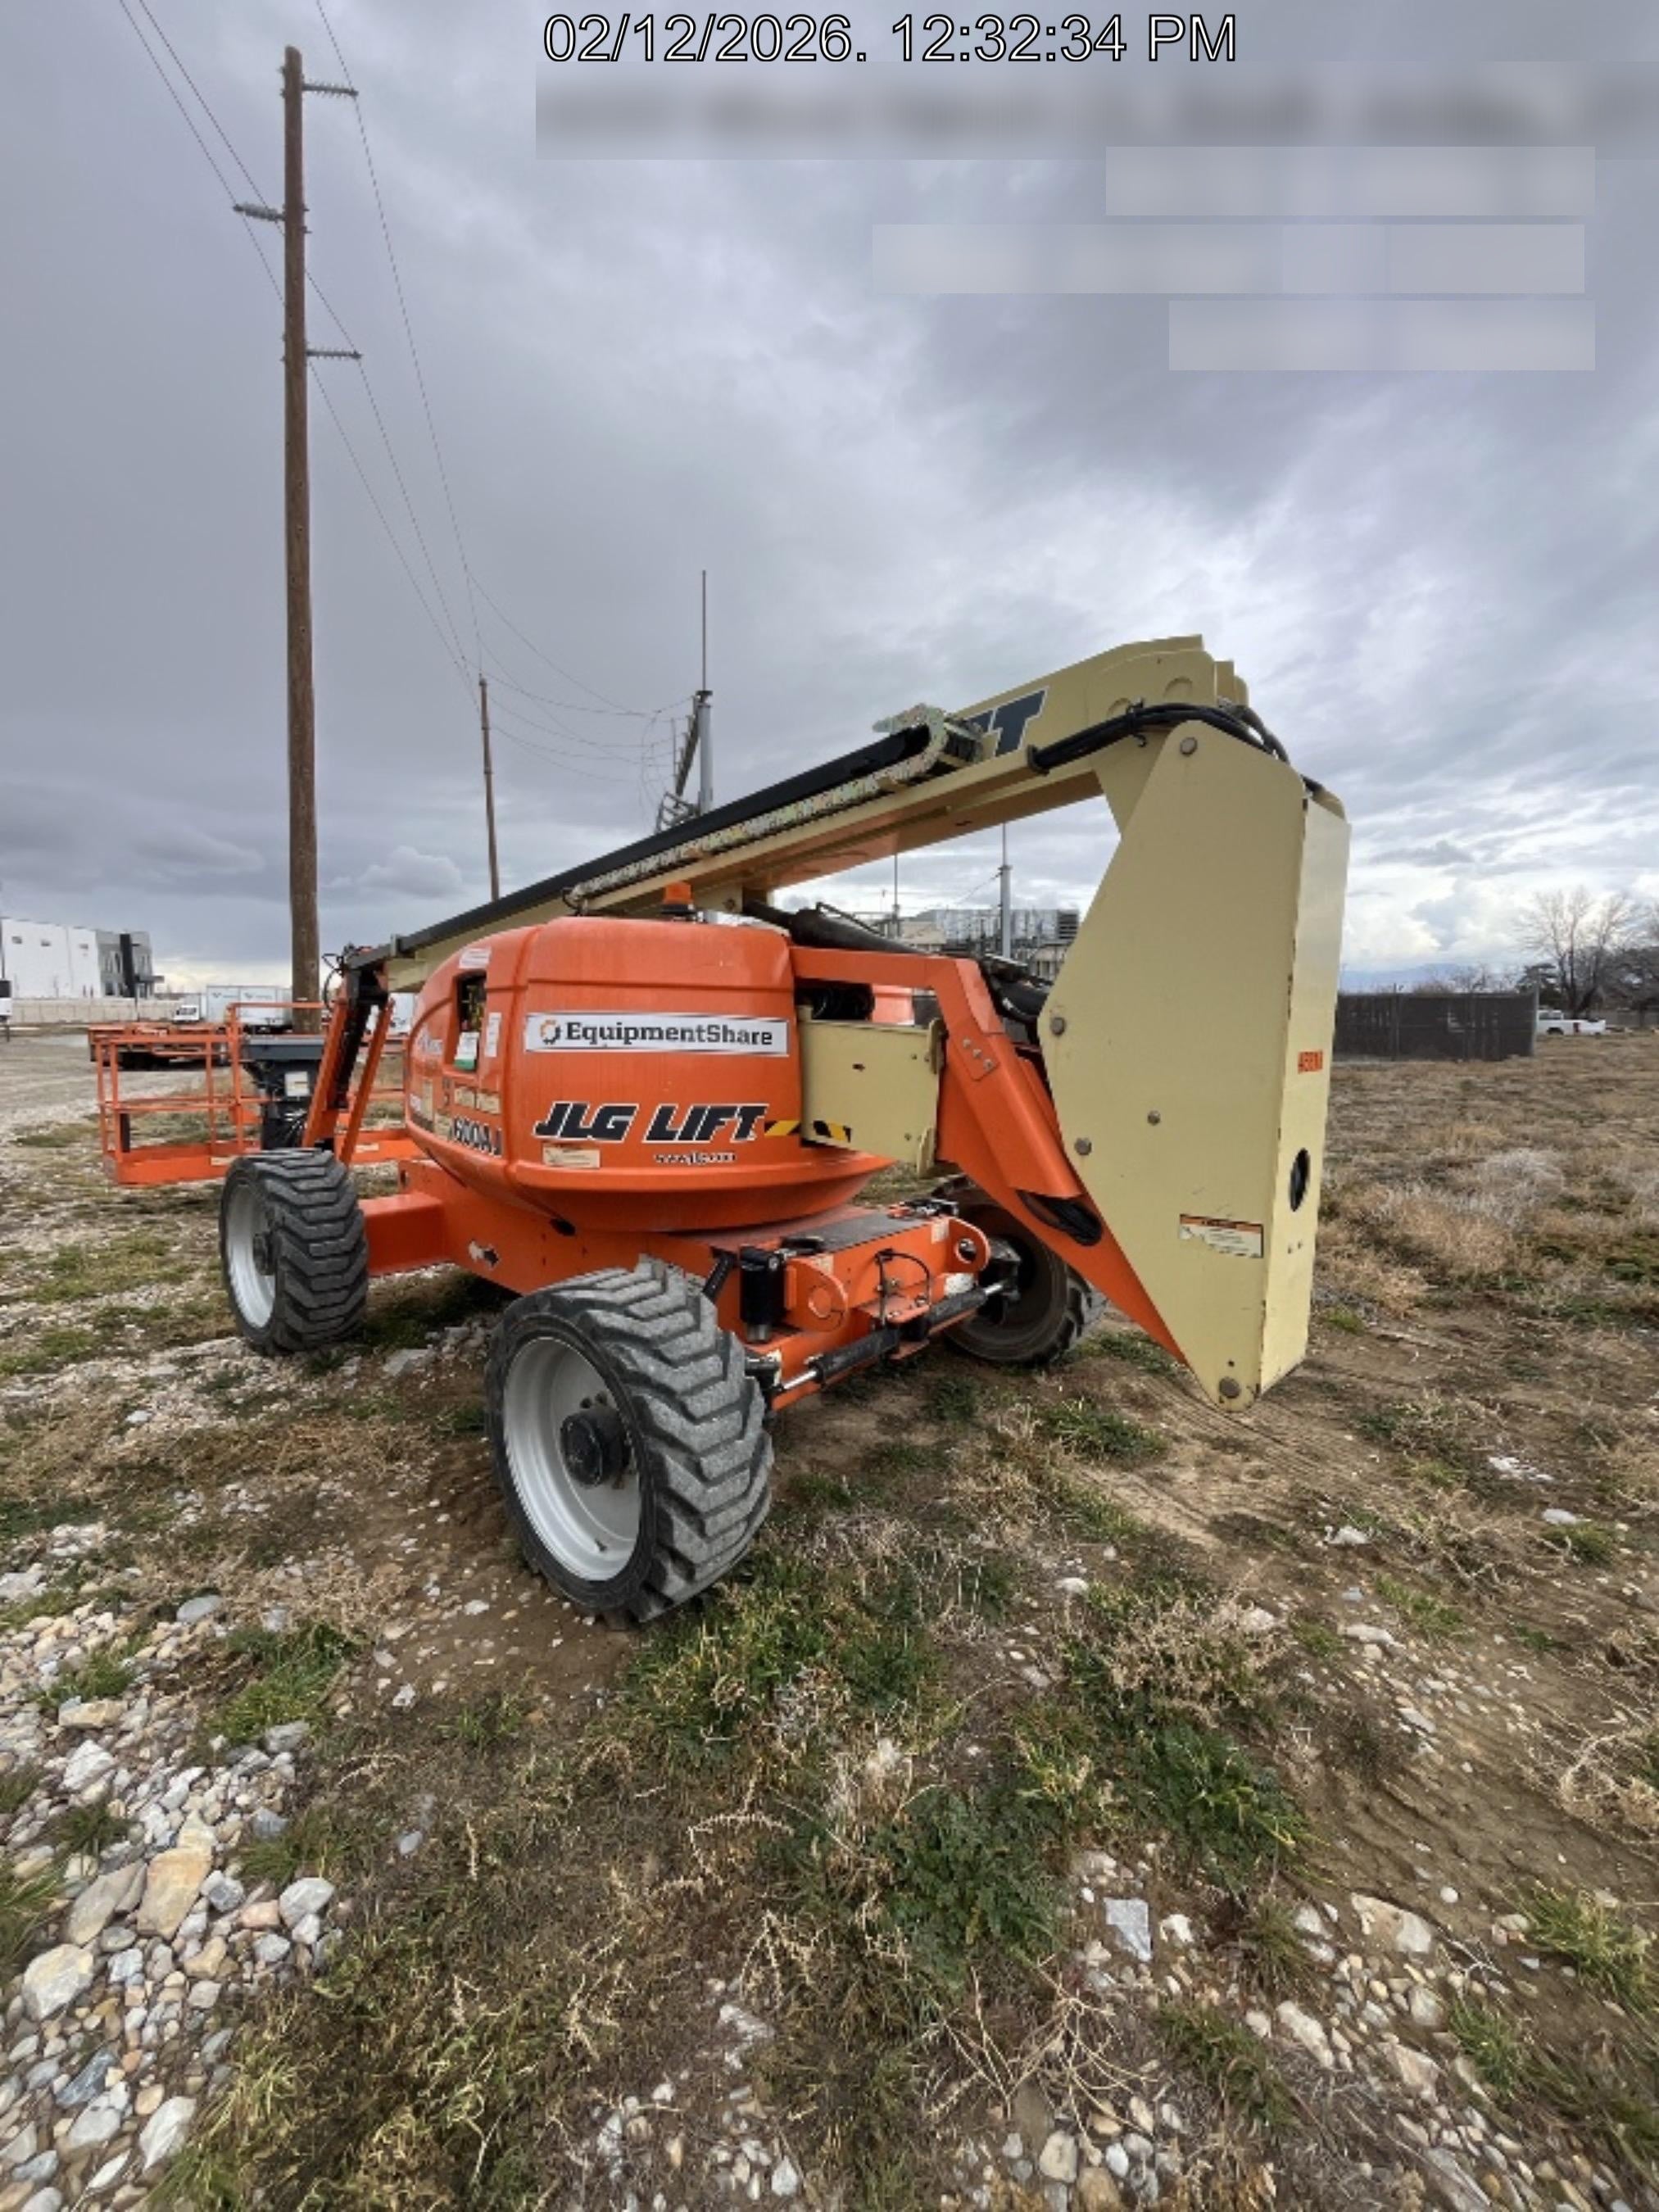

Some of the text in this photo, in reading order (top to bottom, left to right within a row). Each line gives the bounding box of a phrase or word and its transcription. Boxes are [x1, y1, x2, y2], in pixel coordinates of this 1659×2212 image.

[565, 1022, 773, 1046] EquipmentShare
[533, 1101, 639, 1144] JLG
[641, 1103, 770, 1144] LIFT
